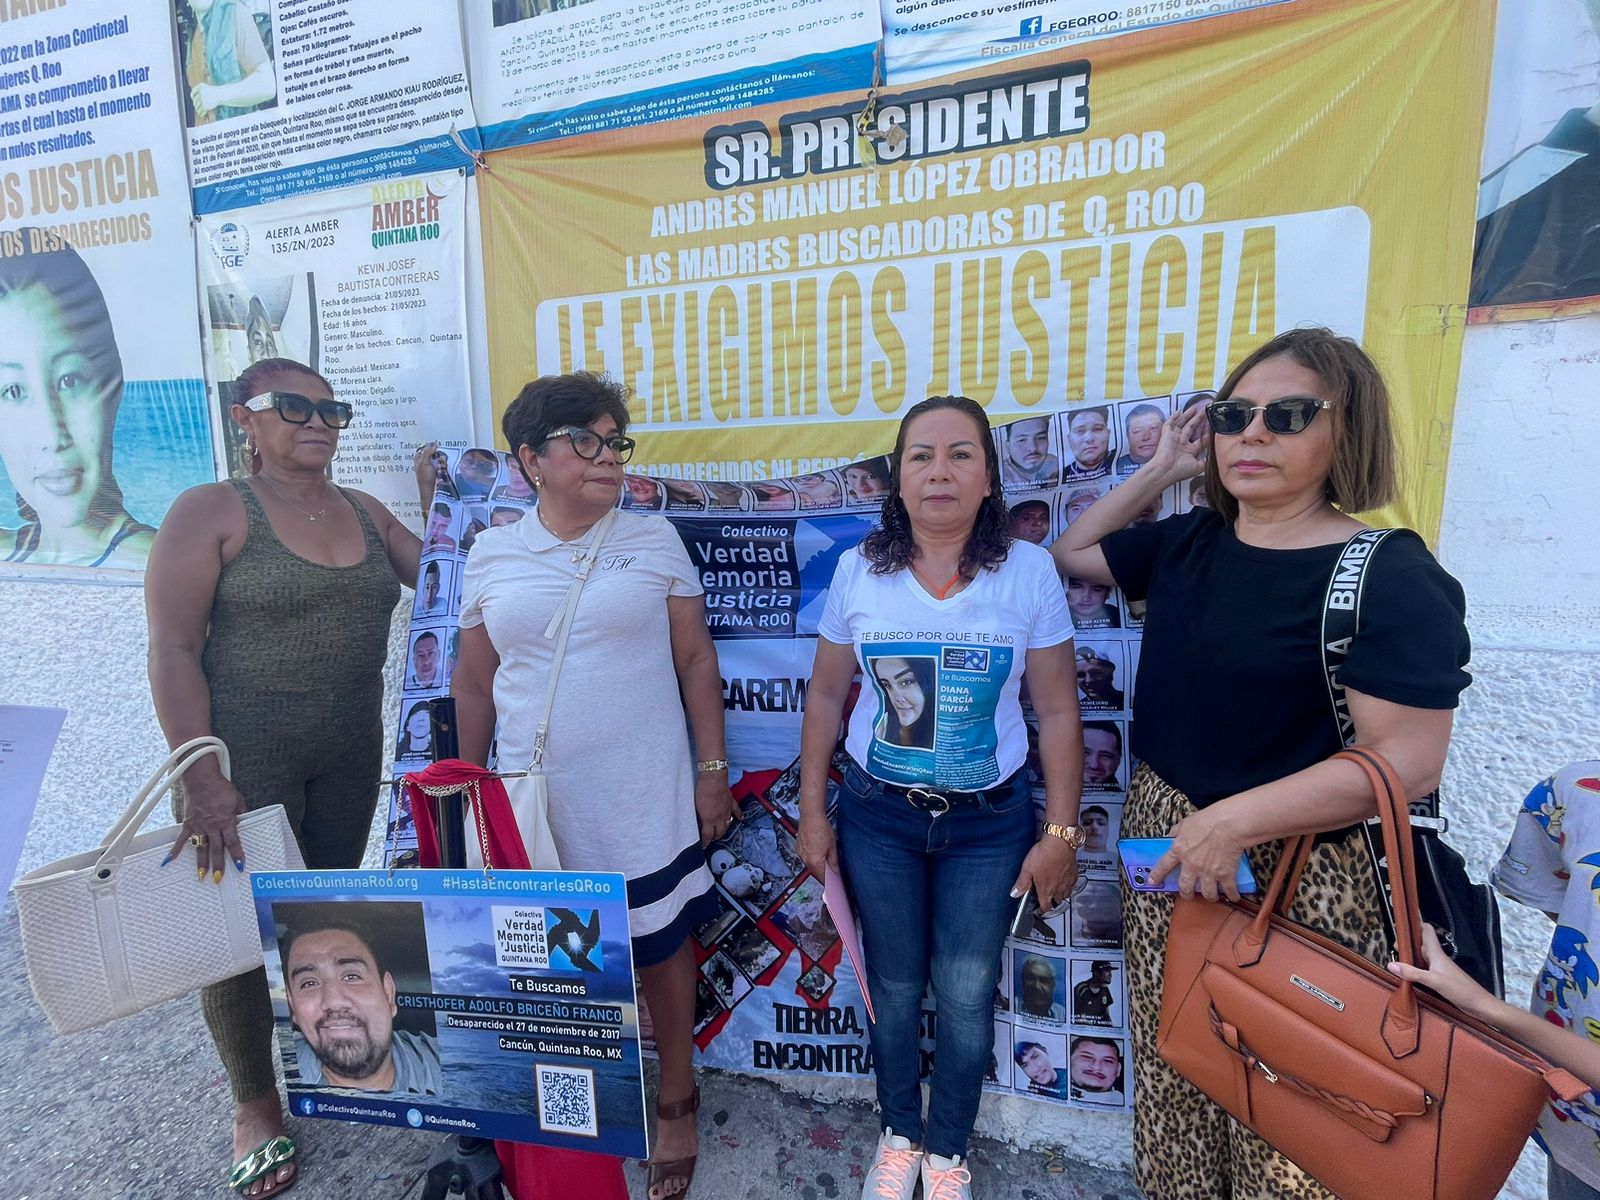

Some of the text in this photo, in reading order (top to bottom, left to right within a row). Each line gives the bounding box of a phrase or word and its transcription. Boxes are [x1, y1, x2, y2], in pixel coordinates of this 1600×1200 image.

[896, 2, 928, 14] algún
[280, 24, 298, 34] Ojos:
[894, 8, 994, 36] Se desconoce su
[1050, 10, 1123, 32] FGEQROO:
[0, 15, 129, 65] 022 en la Zona Continetal
[282, 31, 312, 46] Estatura:
[313, 27, 328, 38] 1.72
[282, 48, 300, 58] Peso:
[302, 44, 310, 53] 70
[283, 26, 422, 70] Señas particulares: Tatuajes en el pecho
[0, 70, 29, 90] ujeres
[42, 62, 62, 79] Roo
[0, 66, 150, 114] AMA se comprometio a llevar
[346, 98, 368, 110] JORGE
[370, 88, 403, 103] ARMANDO
[565, 70, 816, 126] has visto sabes algo de ésta persona contáctanos llámanos:
[0, 92, 152, 138] rtas el cual hasta el momento
[576, 124, 594, 134] (998)
[596, 120, 608, 129] 881
[610, 118, 620, 126] 71
[622, 116, 632, 124] 50
[633, 112, 647, 122] ext.
[650, 108, 668, 118] 2169
[686, 98, 718, 110] número
[720, 96, 735, 104] 998
[738, 87, 775, 100] 1484285
[9, 130, 96, 160] nulos resultados.
[715, 132, 780, 187] SR.
[29, 148, 159, 216] JUSTICIA
[650, 131, 1166, 238] ANDRES MANUEL LÓPEZ OBRADOR
[372, 197, 440, 231] AMBER
[29, 212, 152, 254] DESPARECIDOS
[266, 219, 339, 240] ALERTA AMBER
[372, 223, 440, 250] QUINTANA ROO
[626, 254, 672, 288] LAS
[678, 237, 790, 283] MADRES
[798, 207, 1013, 266] BUSCADORAS
[1023, 200, 1066, 241] DE
[1125, 182, 1206, 229] ROO
[272, 236, 335, 254] 135/ZN/2023
[358, 258, 416, 275] KEVIN JOSEF
[338, 270, 440, 292] BAUTISTA CONTRERAS
[322, 298, 340, 307] Fecha
[342, 296, 350, 305] de
[322, 308, 342, 318] Fecha
[343, 308, 350, 316] de
[352, 306, 362, 315] los
[324, 321, 342, 330] Edad:
[343, 320, 350, 328] 16
[620, 265, 907, 424] EXIGIMOS
[927, 226, 1276, 406] JUSTICIA
[325, 345, 344, 354] Lugar
[346, 343, 354, 351] de
[356, 342, 365, 350] los
[430, 333, 462, 342] Quintana
[624, 460, 766, 481] ESAPARECIDOS
[770, 458, 792, 479] NI
[721, 525, 788, 538] Colectivo
[696, 541, 789, 563] Verdad
[702, 565, 792, 587] emoria
[1328, 528, 1388, 610] BIMBA
[705, 589, 792, 610] usticia
[705, 613, 790, 626] NTANA ROO
[862, 632, 1014, 644] TE BUSCO POR QUE TE AMO
[952, 674, 990, 683] Buscamos
[940, 686, 969, 694] DIANA
[940, 704, 969, 712] RIVERA
[256, 876, 611, 894] ColectivoQuintanaRoo.org #HastaEncontrarlesQRoo
[504, 918, 544, 932] Verdad
[514, 910, 542, 918] Colectivo
[498, 930, 544, 943] Memoria
[505, 941, 546, 954] Justicia
[502, 955, 548, 964] QUINTANA ROO
[510, 978, 586, 995] Te Buscamos
[397, 996, 622, 1022] CRISTHOFER ADOLFO BRICEÑO FRANCO
[448, 1016, 620, 1040] Desaparecido el 27 de noviembre de 2017
[772, 1002, 864, 1039] TIERRA,
[499, 1037, 622, 1059] Cancún, Quintana Roo, MX
[753, 1040, 876, 1074] ENCONTRA
[317, 1101, 396, 1119] @ColectivoQuintanaRoo
